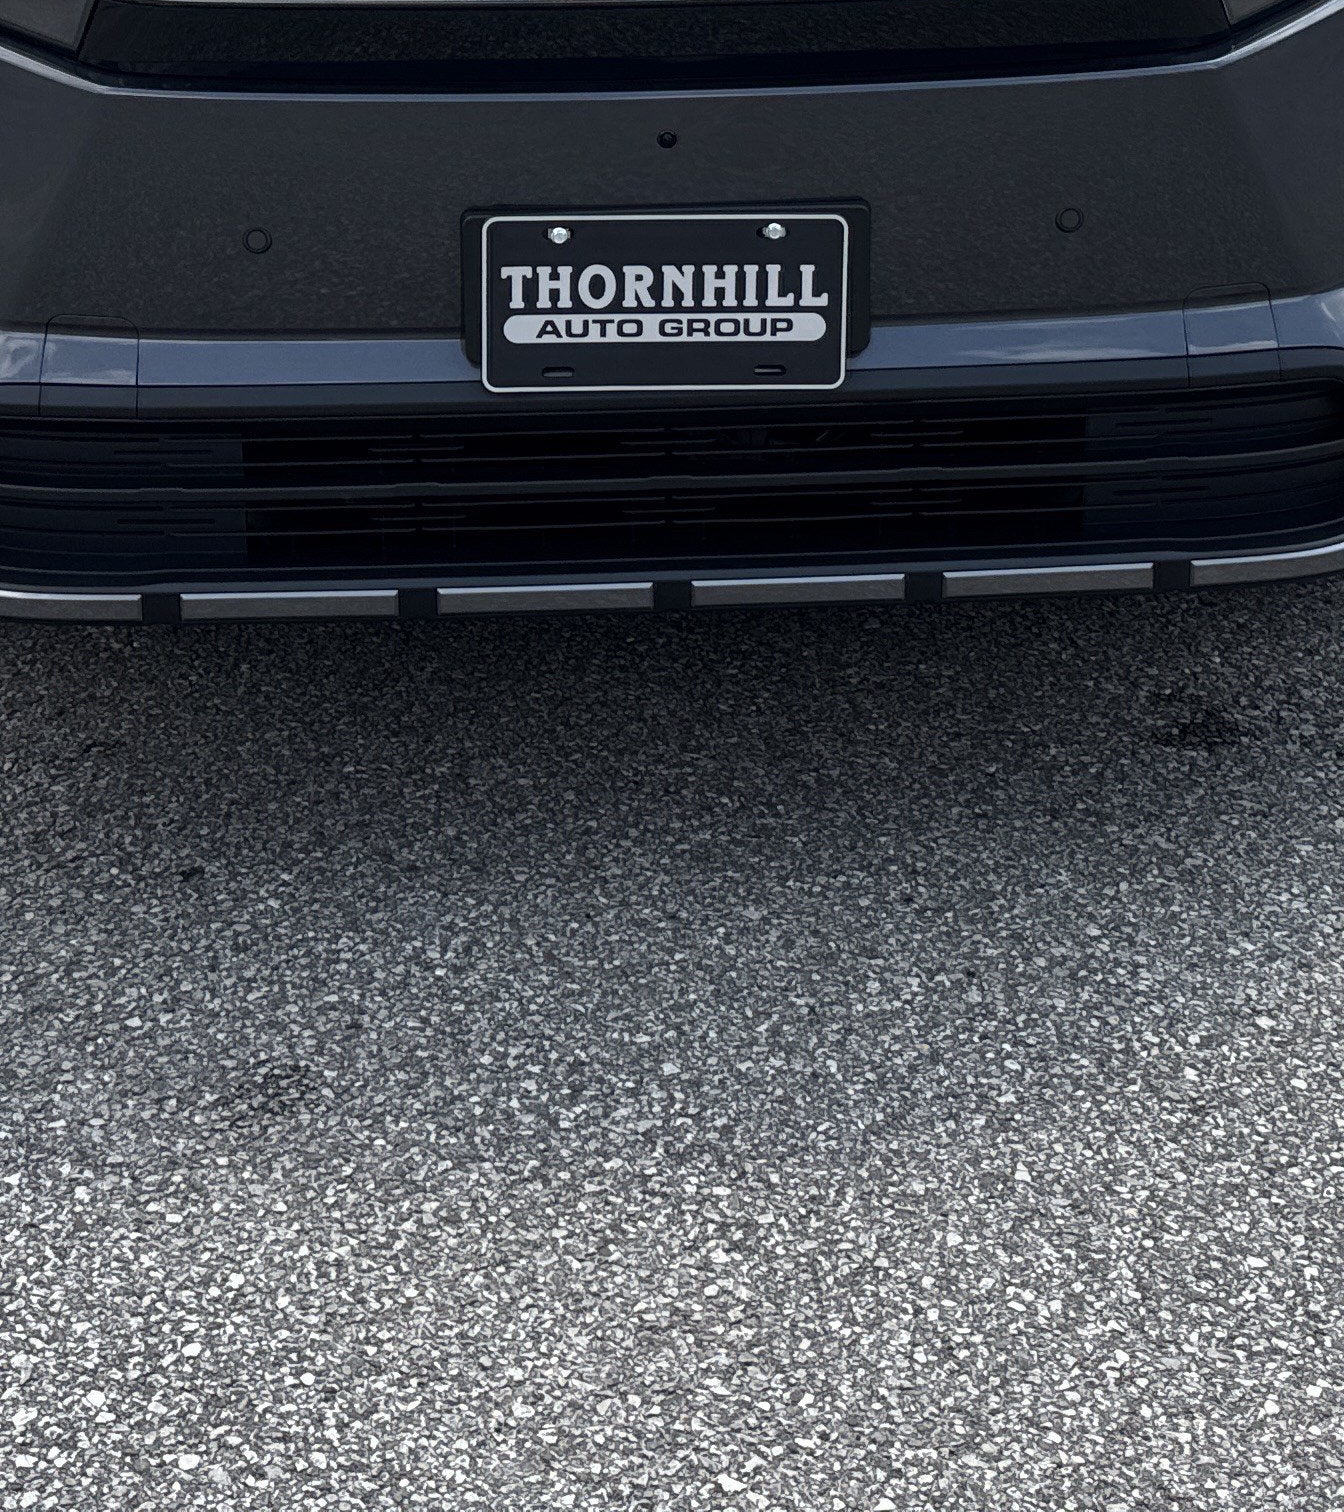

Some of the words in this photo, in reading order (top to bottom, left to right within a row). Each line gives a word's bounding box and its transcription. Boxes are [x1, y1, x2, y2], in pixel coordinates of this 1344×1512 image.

[500, 263, 829, 310] THORNHILL
[535, 317, 644, 339] AUTO
[658, 317, 794, 338] GROUP
